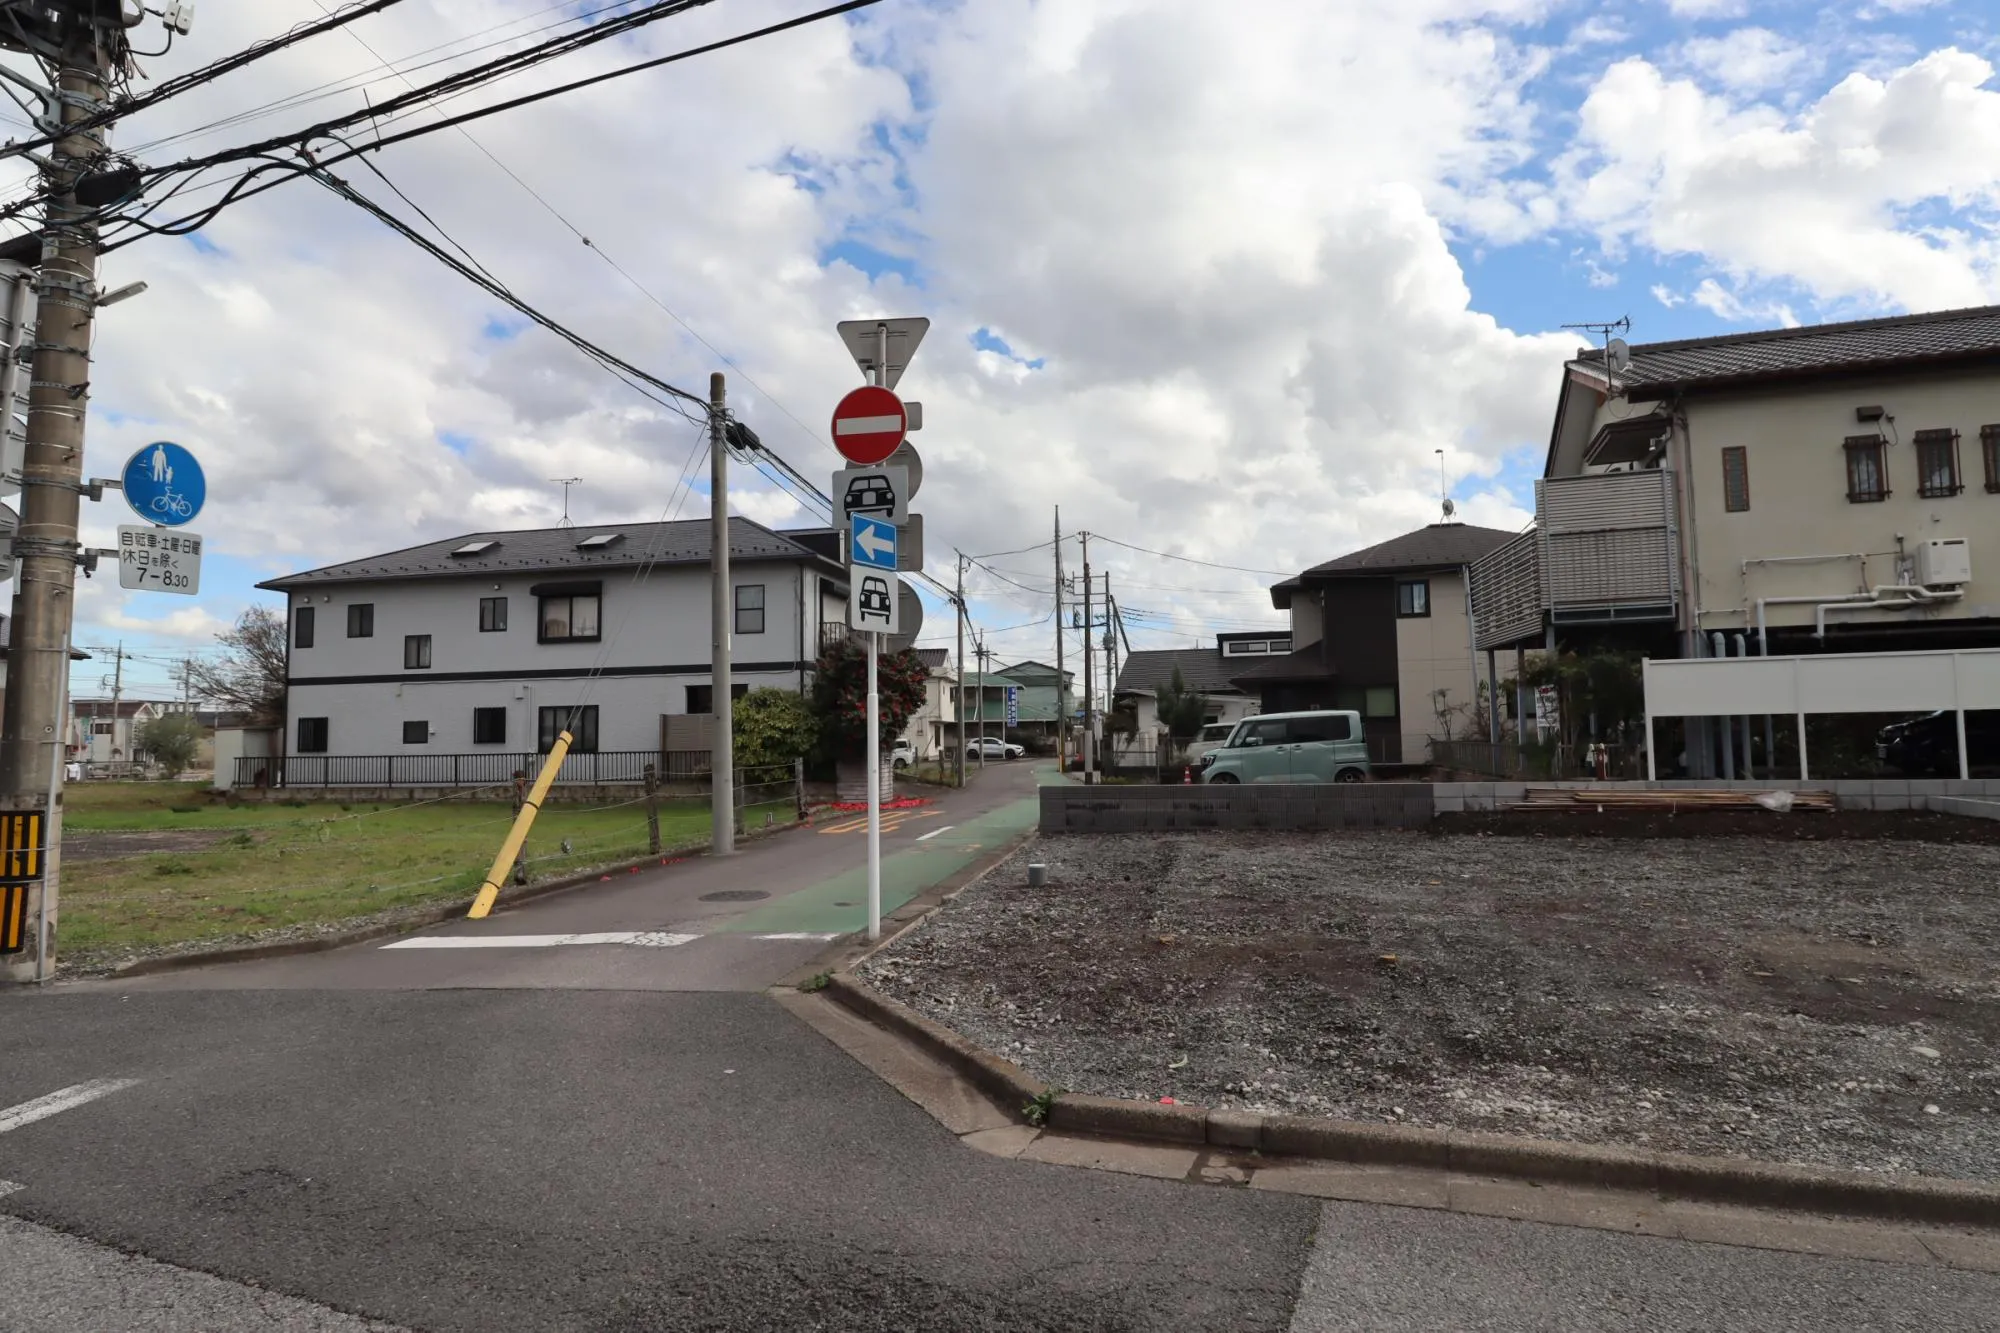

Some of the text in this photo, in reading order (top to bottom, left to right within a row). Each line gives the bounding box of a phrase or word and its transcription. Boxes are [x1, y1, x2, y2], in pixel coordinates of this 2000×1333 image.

[122, 549, 178, 569] 休日を除く
